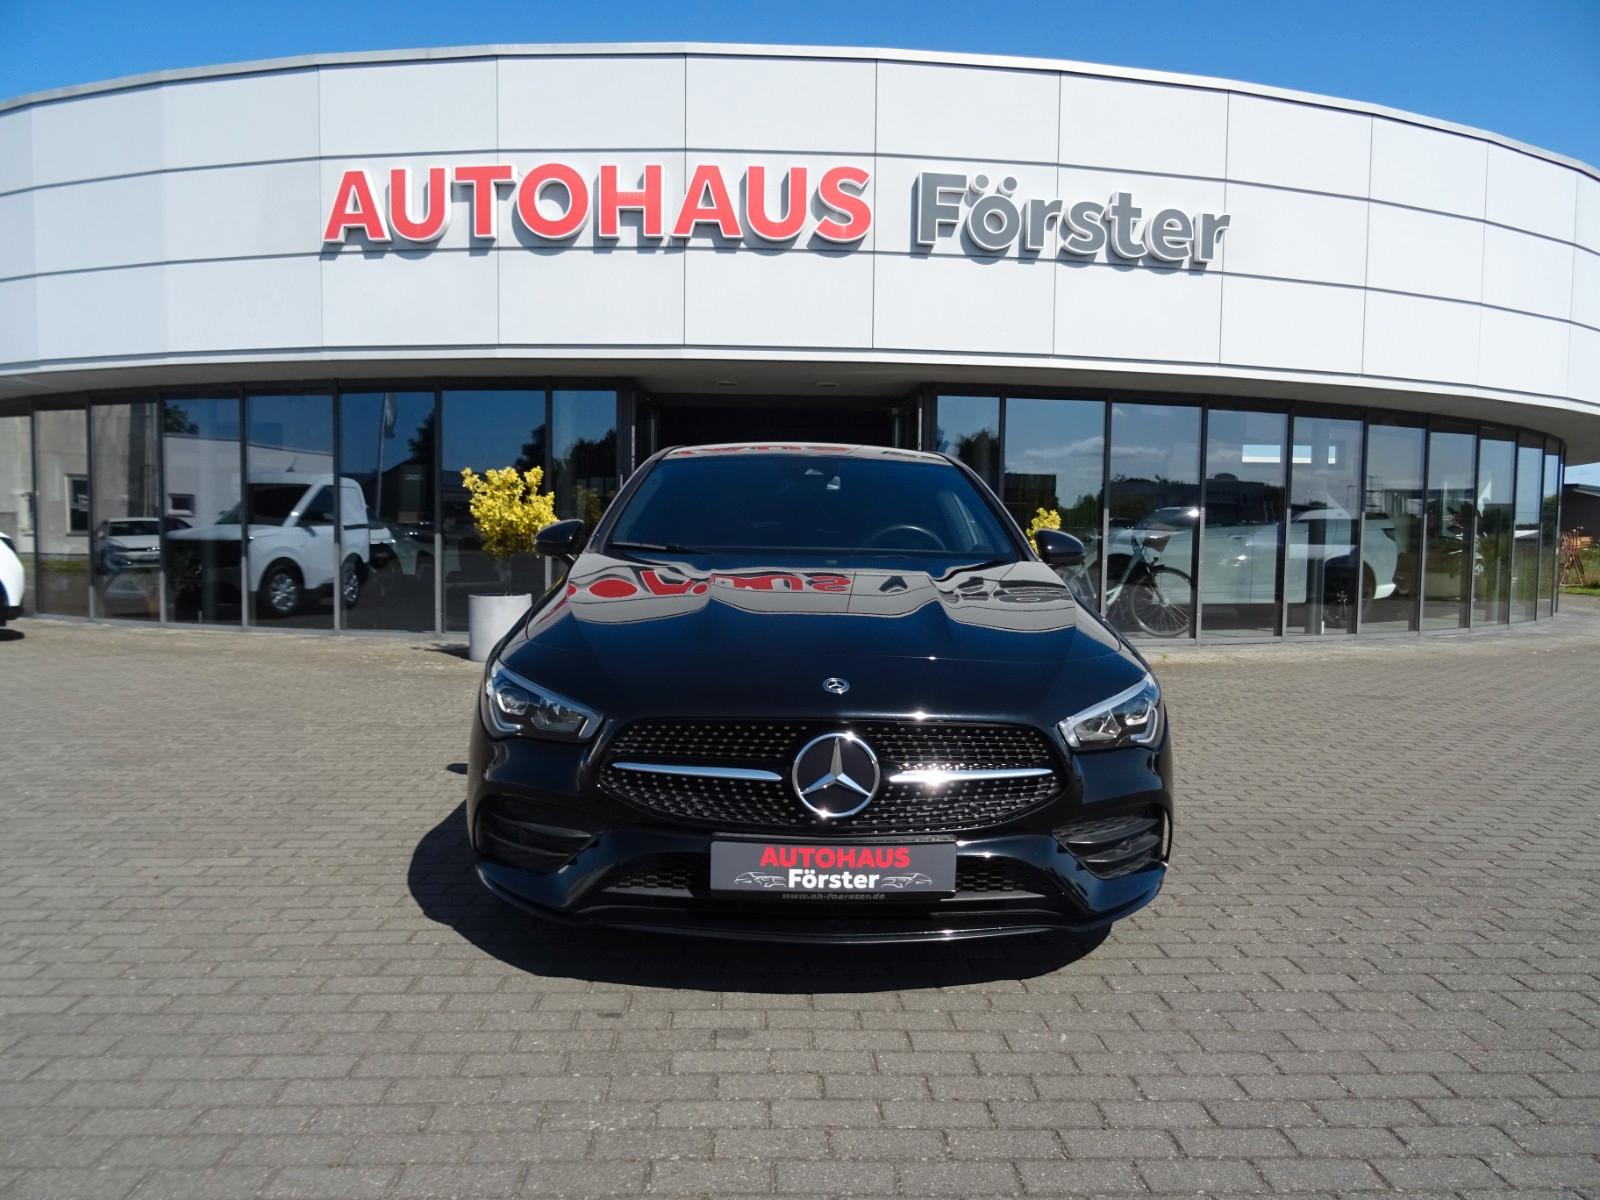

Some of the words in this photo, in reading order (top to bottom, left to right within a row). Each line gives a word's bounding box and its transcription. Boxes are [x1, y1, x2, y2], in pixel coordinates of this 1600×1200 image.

[323, 162, 872, 245] AUTOHAUS
[915, 171, 1231, 266] Förster
[761, 847, 910, 868] AUTOHAUS
[788, 869, 880, 889] Förster
